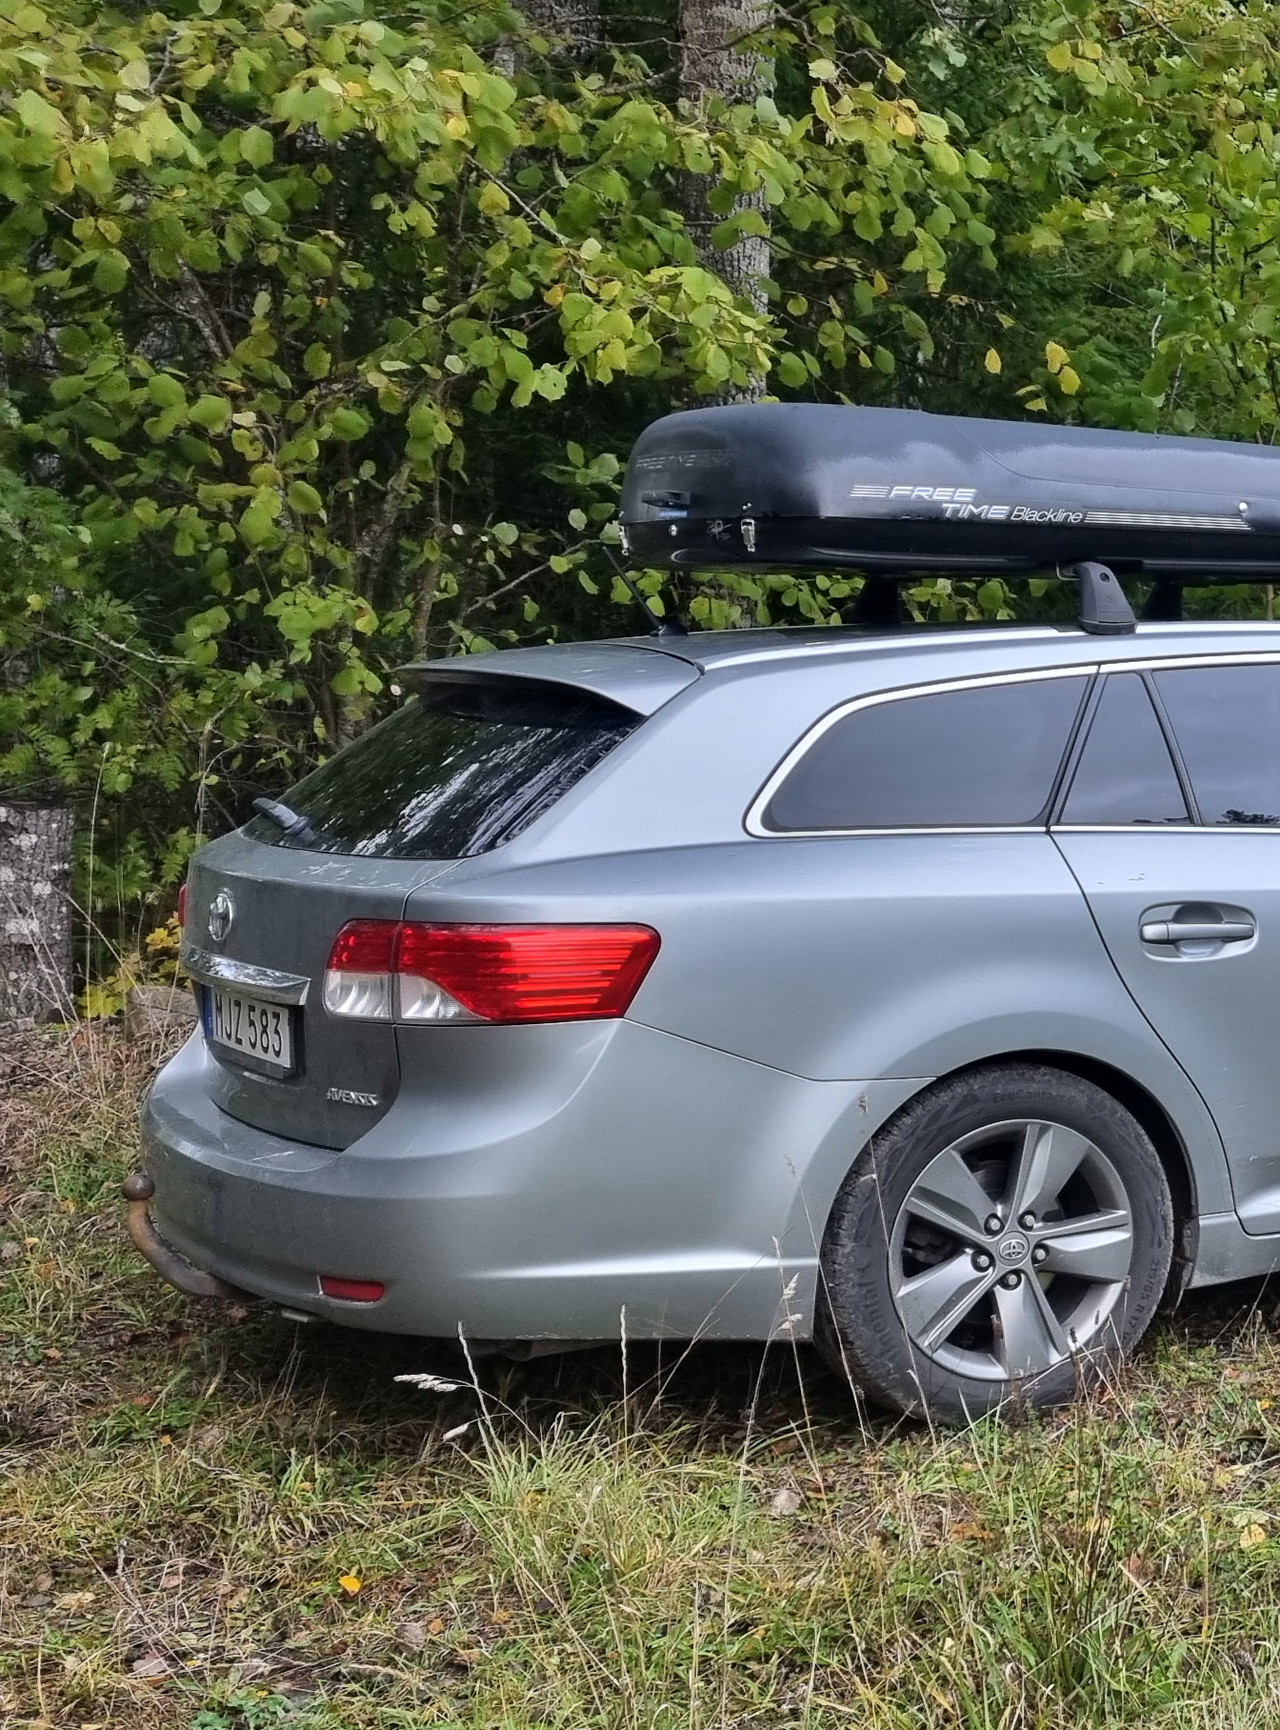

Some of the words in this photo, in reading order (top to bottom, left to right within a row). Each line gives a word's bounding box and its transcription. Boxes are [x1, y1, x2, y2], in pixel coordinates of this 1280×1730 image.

[889, 486, 977, 503] FREE
[942, 502, 1011, 520] TIME
[1010, 506, 1083, 524] Blackline
[215, 993, 243, 1046] MJZ
[247, 1004, 283, 1058] 583
[326, 1087, 379, 1106] AVENSIS
